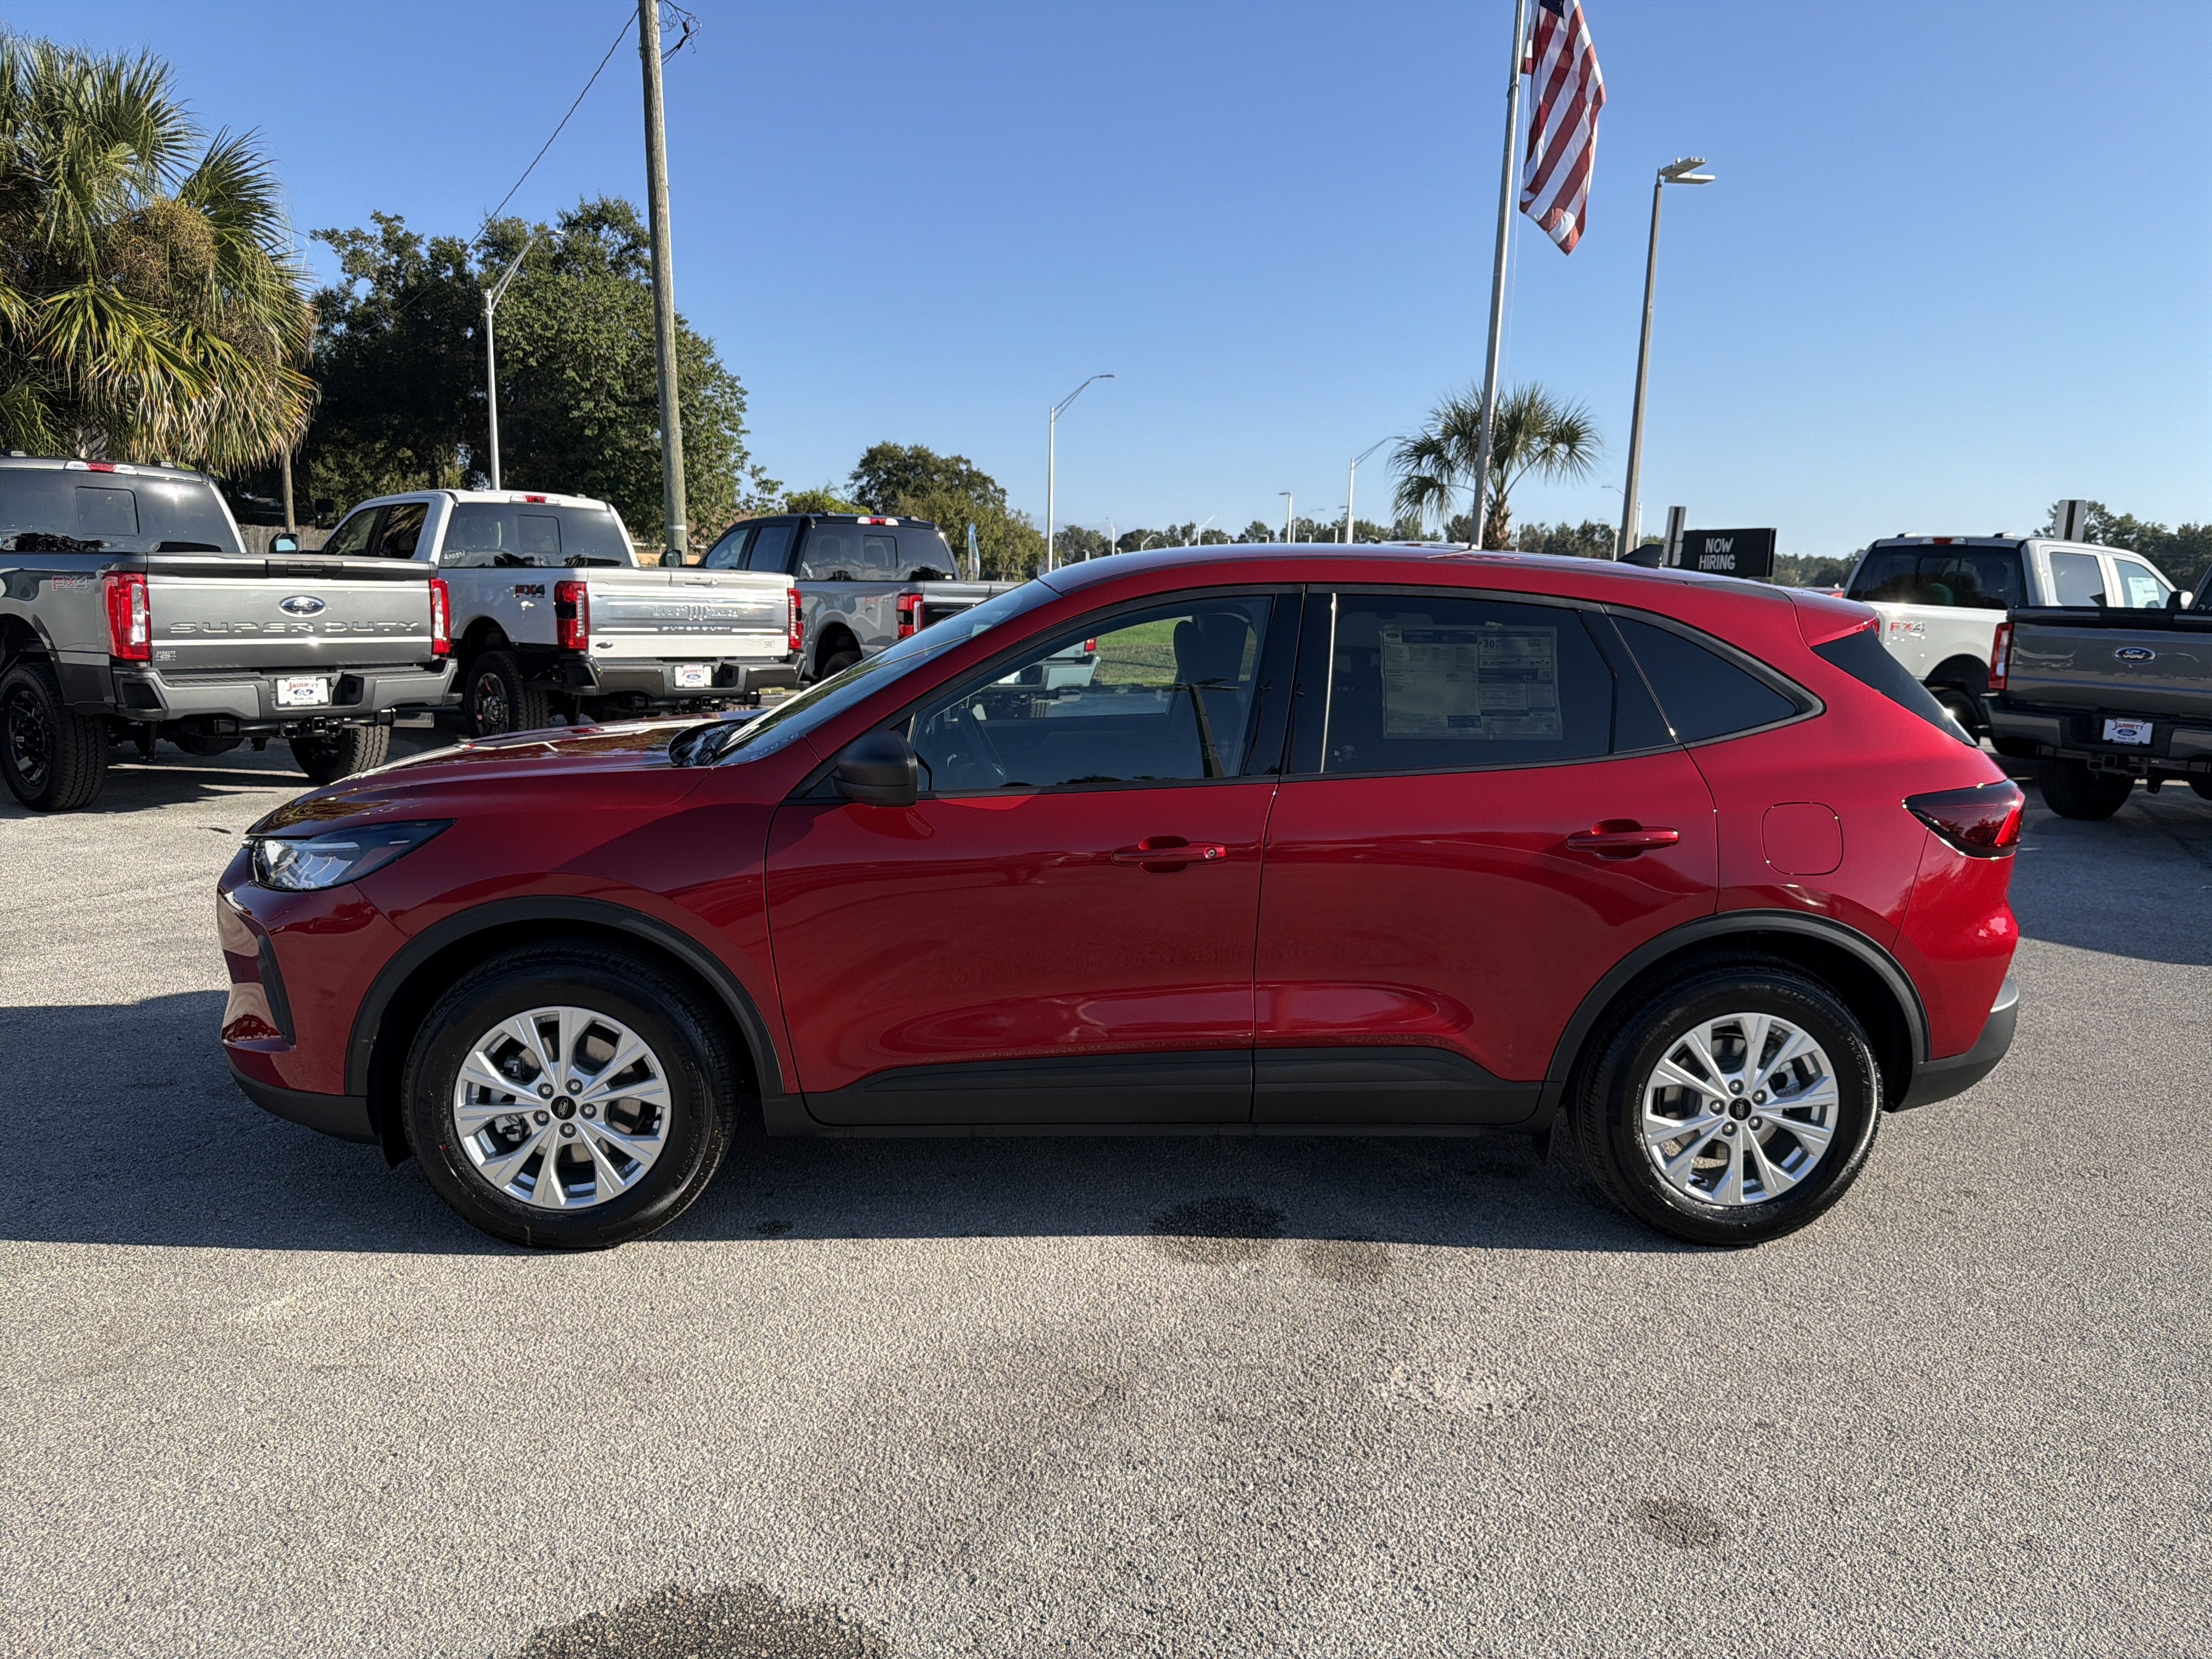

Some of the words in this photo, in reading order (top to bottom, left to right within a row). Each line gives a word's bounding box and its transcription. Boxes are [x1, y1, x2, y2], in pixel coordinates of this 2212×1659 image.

[1705, 538, 1734, 554] NOW
[1698, 554, 1736, 570] HIRING
[52, 576, 89, 592] FX4
[515, 584, 545, 598] FX4
[170, 622, 314, 633] SUPER
[325, 621, 419, 633] DUTY
[1889, 622, 1925, 633] FX4
[1483, 640, 1495, 648] 30
[2122, 650, 2147, 659] Ford
